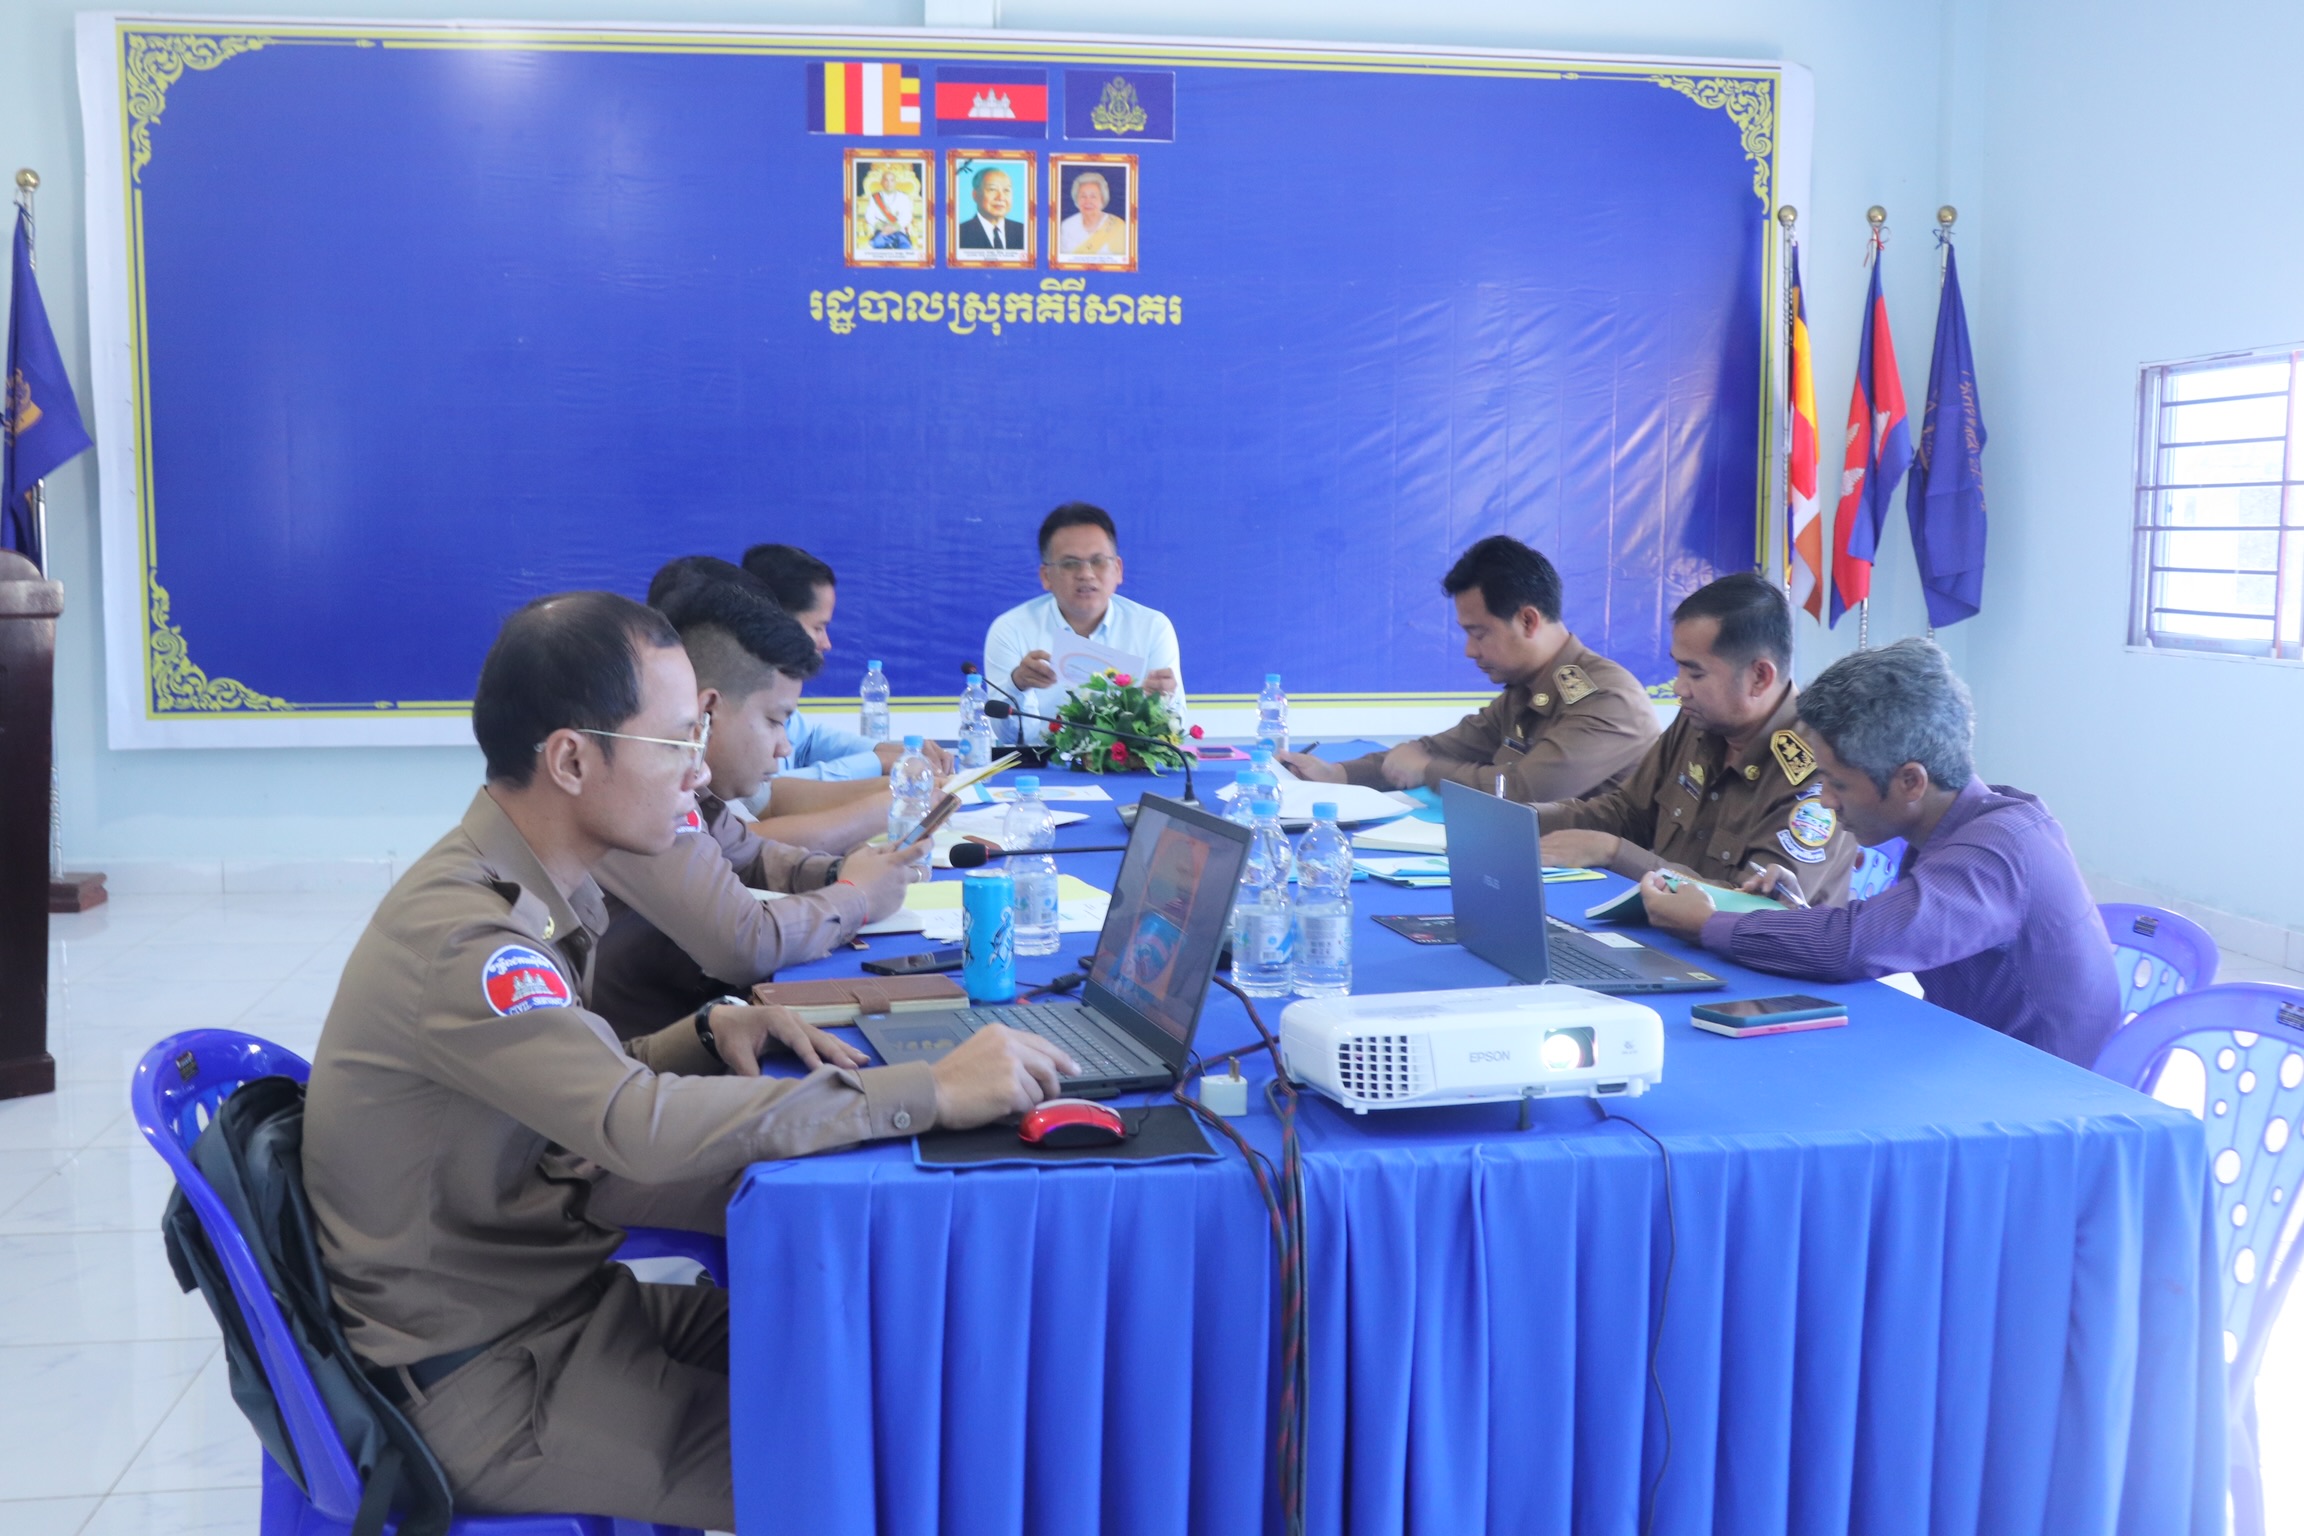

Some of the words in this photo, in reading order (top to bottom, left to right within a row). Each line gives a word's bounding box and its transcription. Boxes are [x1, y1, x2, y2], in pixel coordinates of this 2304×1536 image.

[809, 277, 1183, 336] រដ្ឋបាលស្រុកគិរីសាគរ
[1469, 1050, 1511, 1063] EPSON
